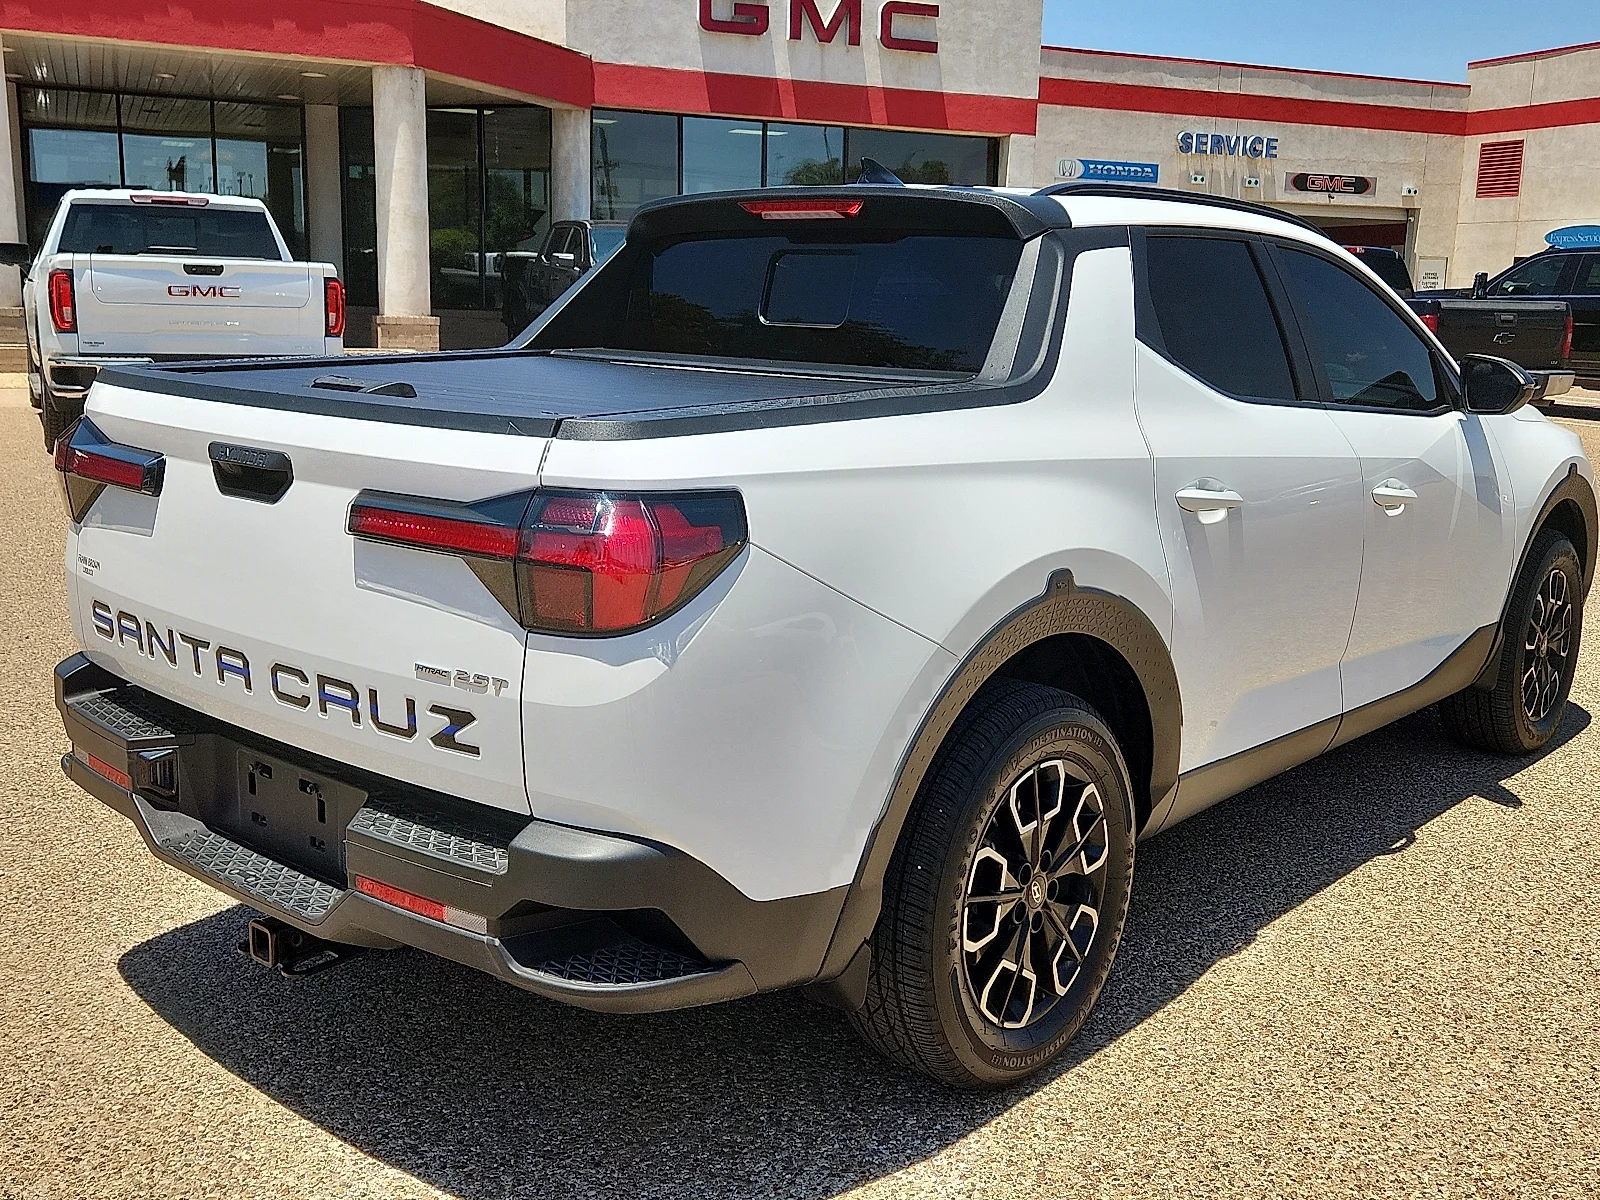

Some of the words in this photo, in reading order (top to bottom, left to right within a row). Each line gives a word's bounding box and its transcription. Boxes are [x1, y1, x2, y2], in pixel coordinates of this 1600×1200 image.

[697, 0, 940, 54] GMC
[1177, 131, 1279, 158] SERVICE
[1087, 163, 1155, 180] HONDA
[1306, 174, 1355, 192] GMC
[167, 284, 241, 298] GMC
[91, 599, 253, 694] SANTA
[269, 662, 481, 758] CRUZ
[415, 663, 450, 679] HTRAC
[1032, 726, 1093, 750] DESTINATION
[1003, 1031, 1066, 1068] DESTINATION
